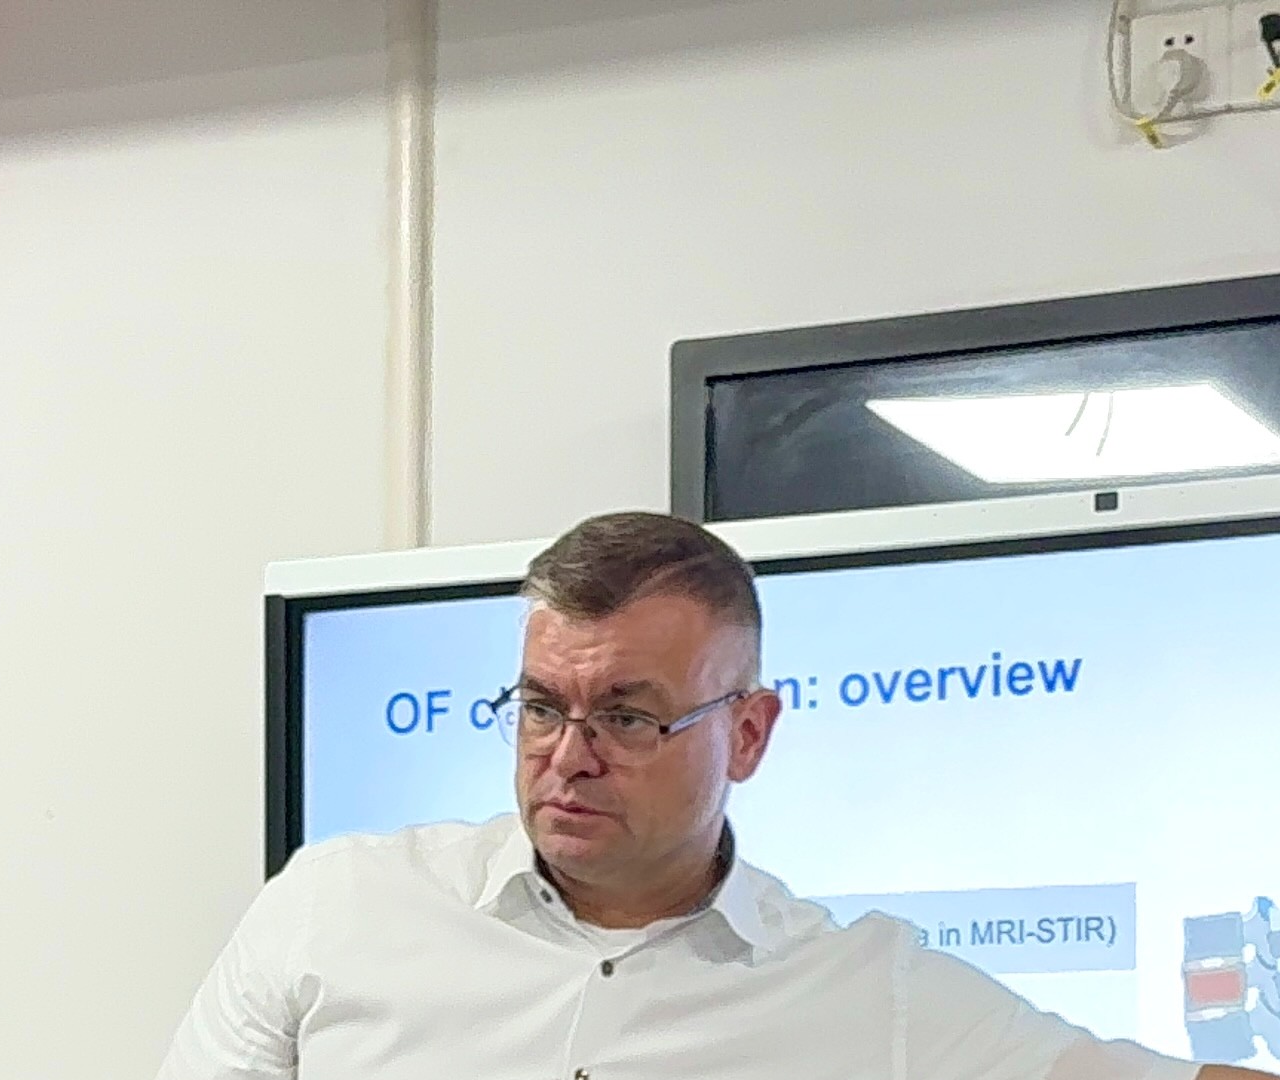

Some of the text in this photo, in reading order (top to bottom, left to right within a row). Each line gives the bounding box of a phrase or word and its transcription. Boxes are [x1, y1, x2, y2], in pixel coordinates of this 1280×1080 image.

[385, 689, 451, 734] OF
[839, 651, 1083, 707] overview
[939, 921, 961, 947] in
[971, 915, 1117, 946] MRI-STIR)
